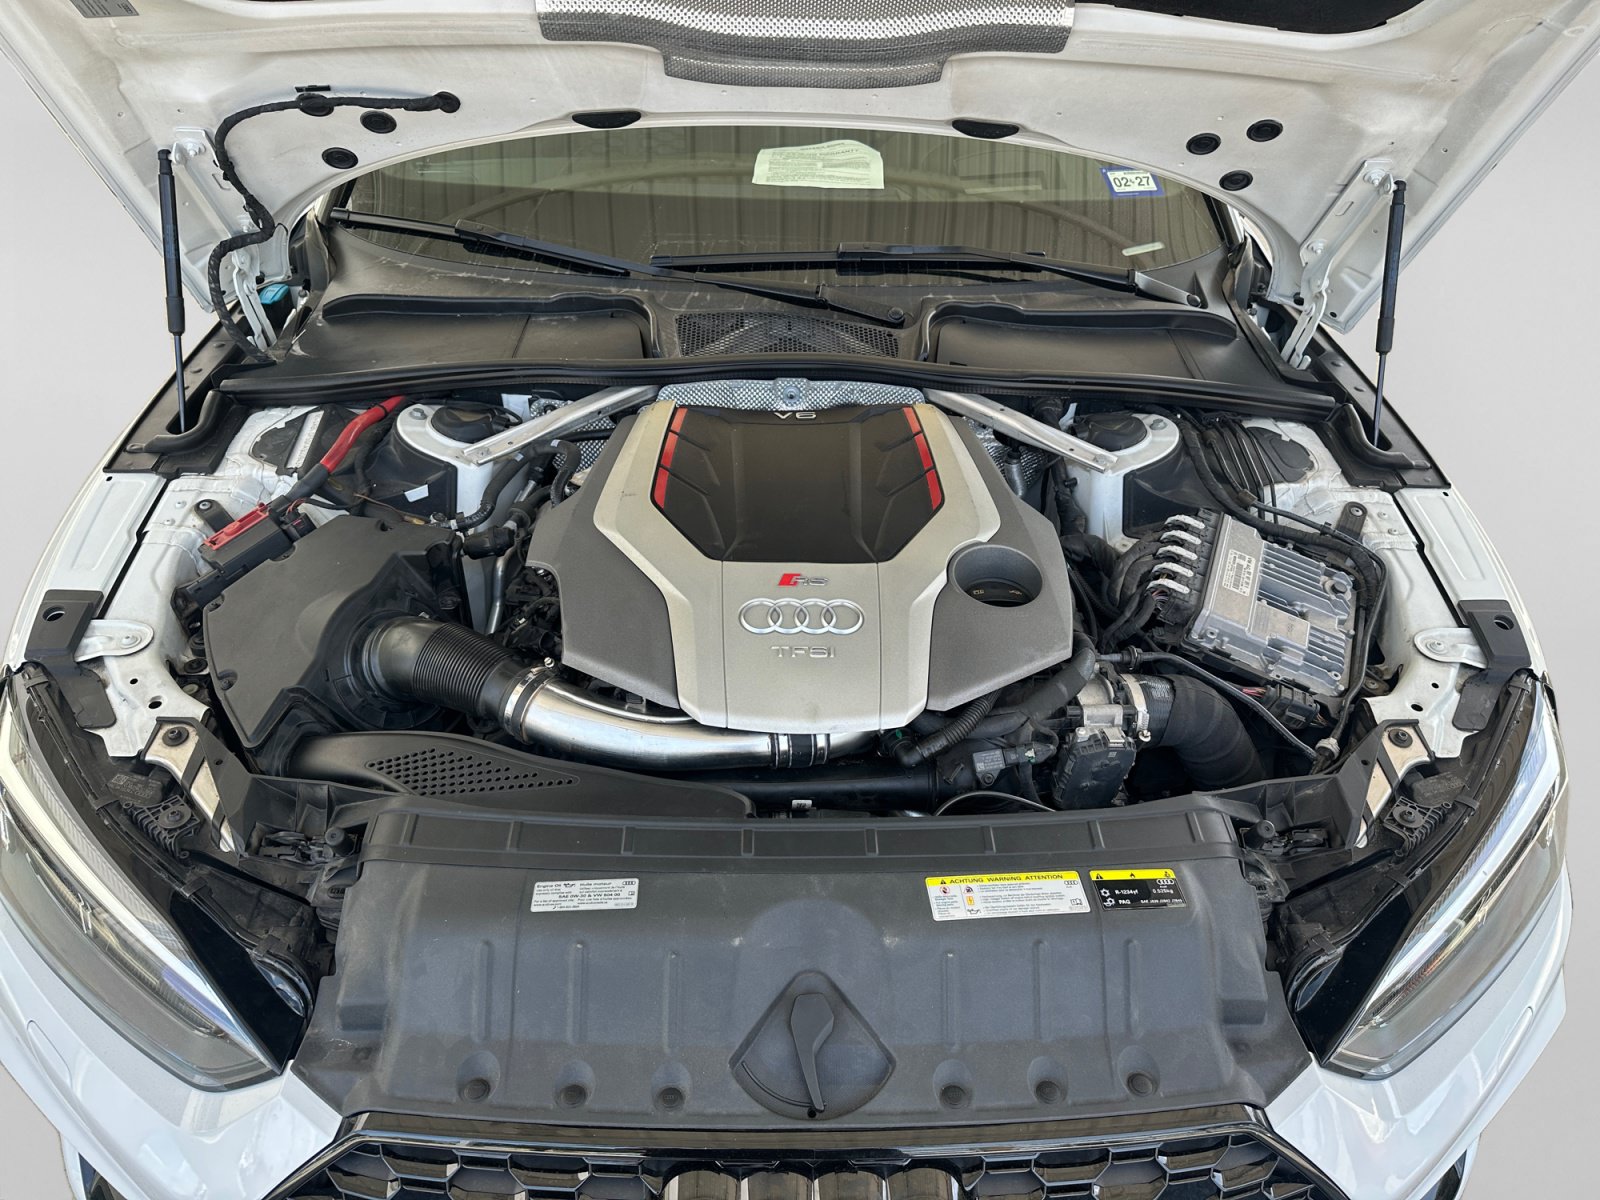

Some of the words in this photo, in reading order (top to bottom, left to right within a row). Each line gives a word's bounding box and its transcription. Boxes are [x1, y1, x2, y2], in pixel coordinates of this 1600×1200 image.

[1113, 177, 1131, 187] 02
[1135, 176, 1150, 186] 27
[774, 411, 817, 419] V6
[785, 574, 829, 586] RS
[771, 646, 835, 658] TFSI
